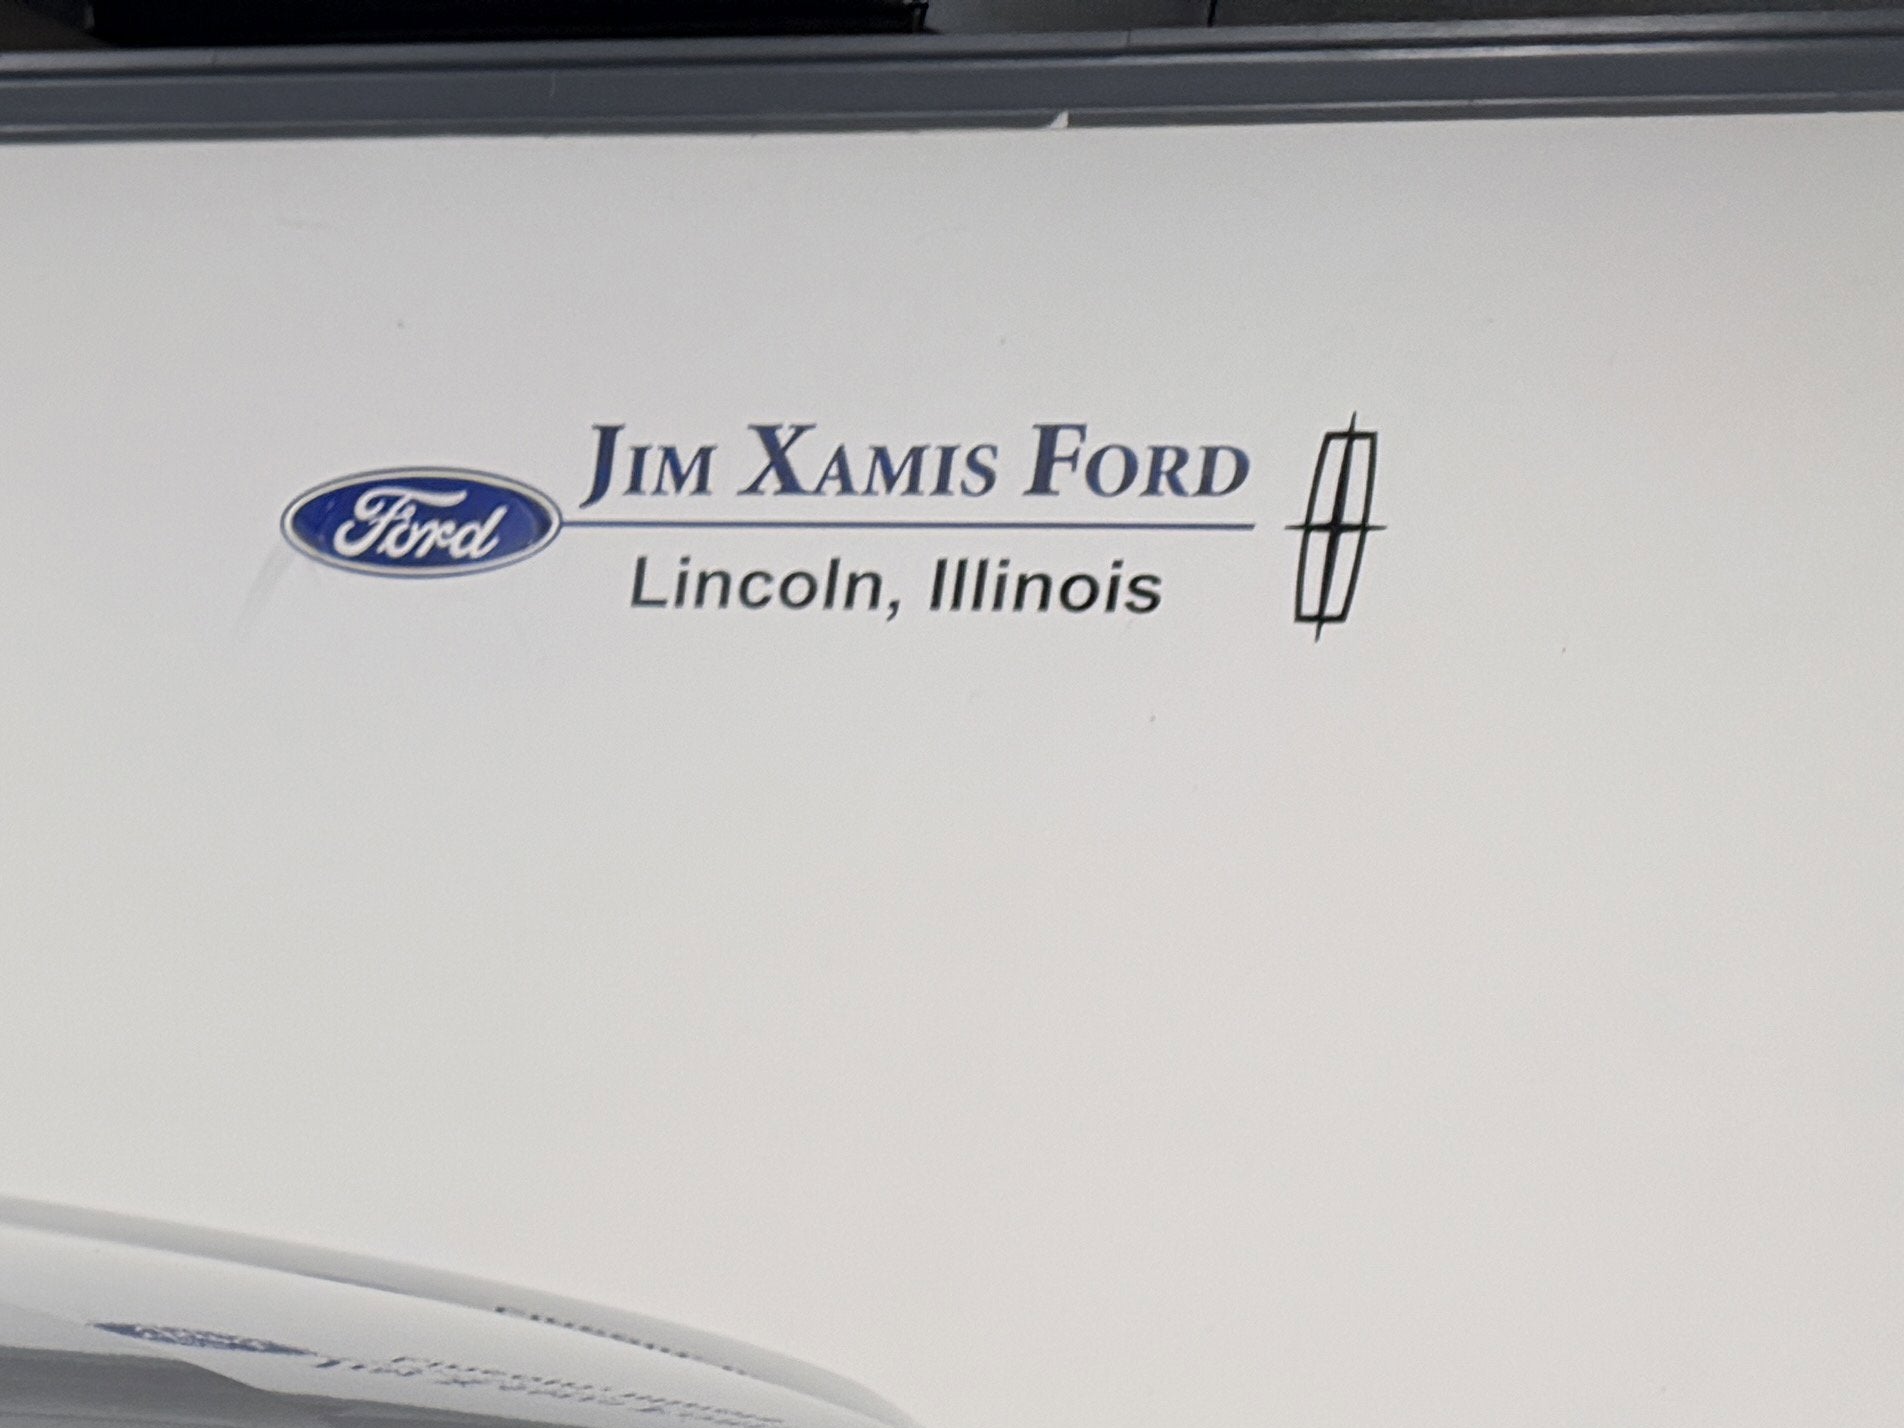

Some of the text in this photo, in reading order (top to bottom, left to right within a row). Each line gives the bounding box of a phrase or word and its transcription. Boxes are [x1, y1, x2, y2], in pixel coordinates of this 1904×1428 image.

[581, 423, 1250, 510] JIM XAMIS FORD
[332, 488, 499, 562] Ford
[631, 556, 1162, 622] Lincoln, Illinois
